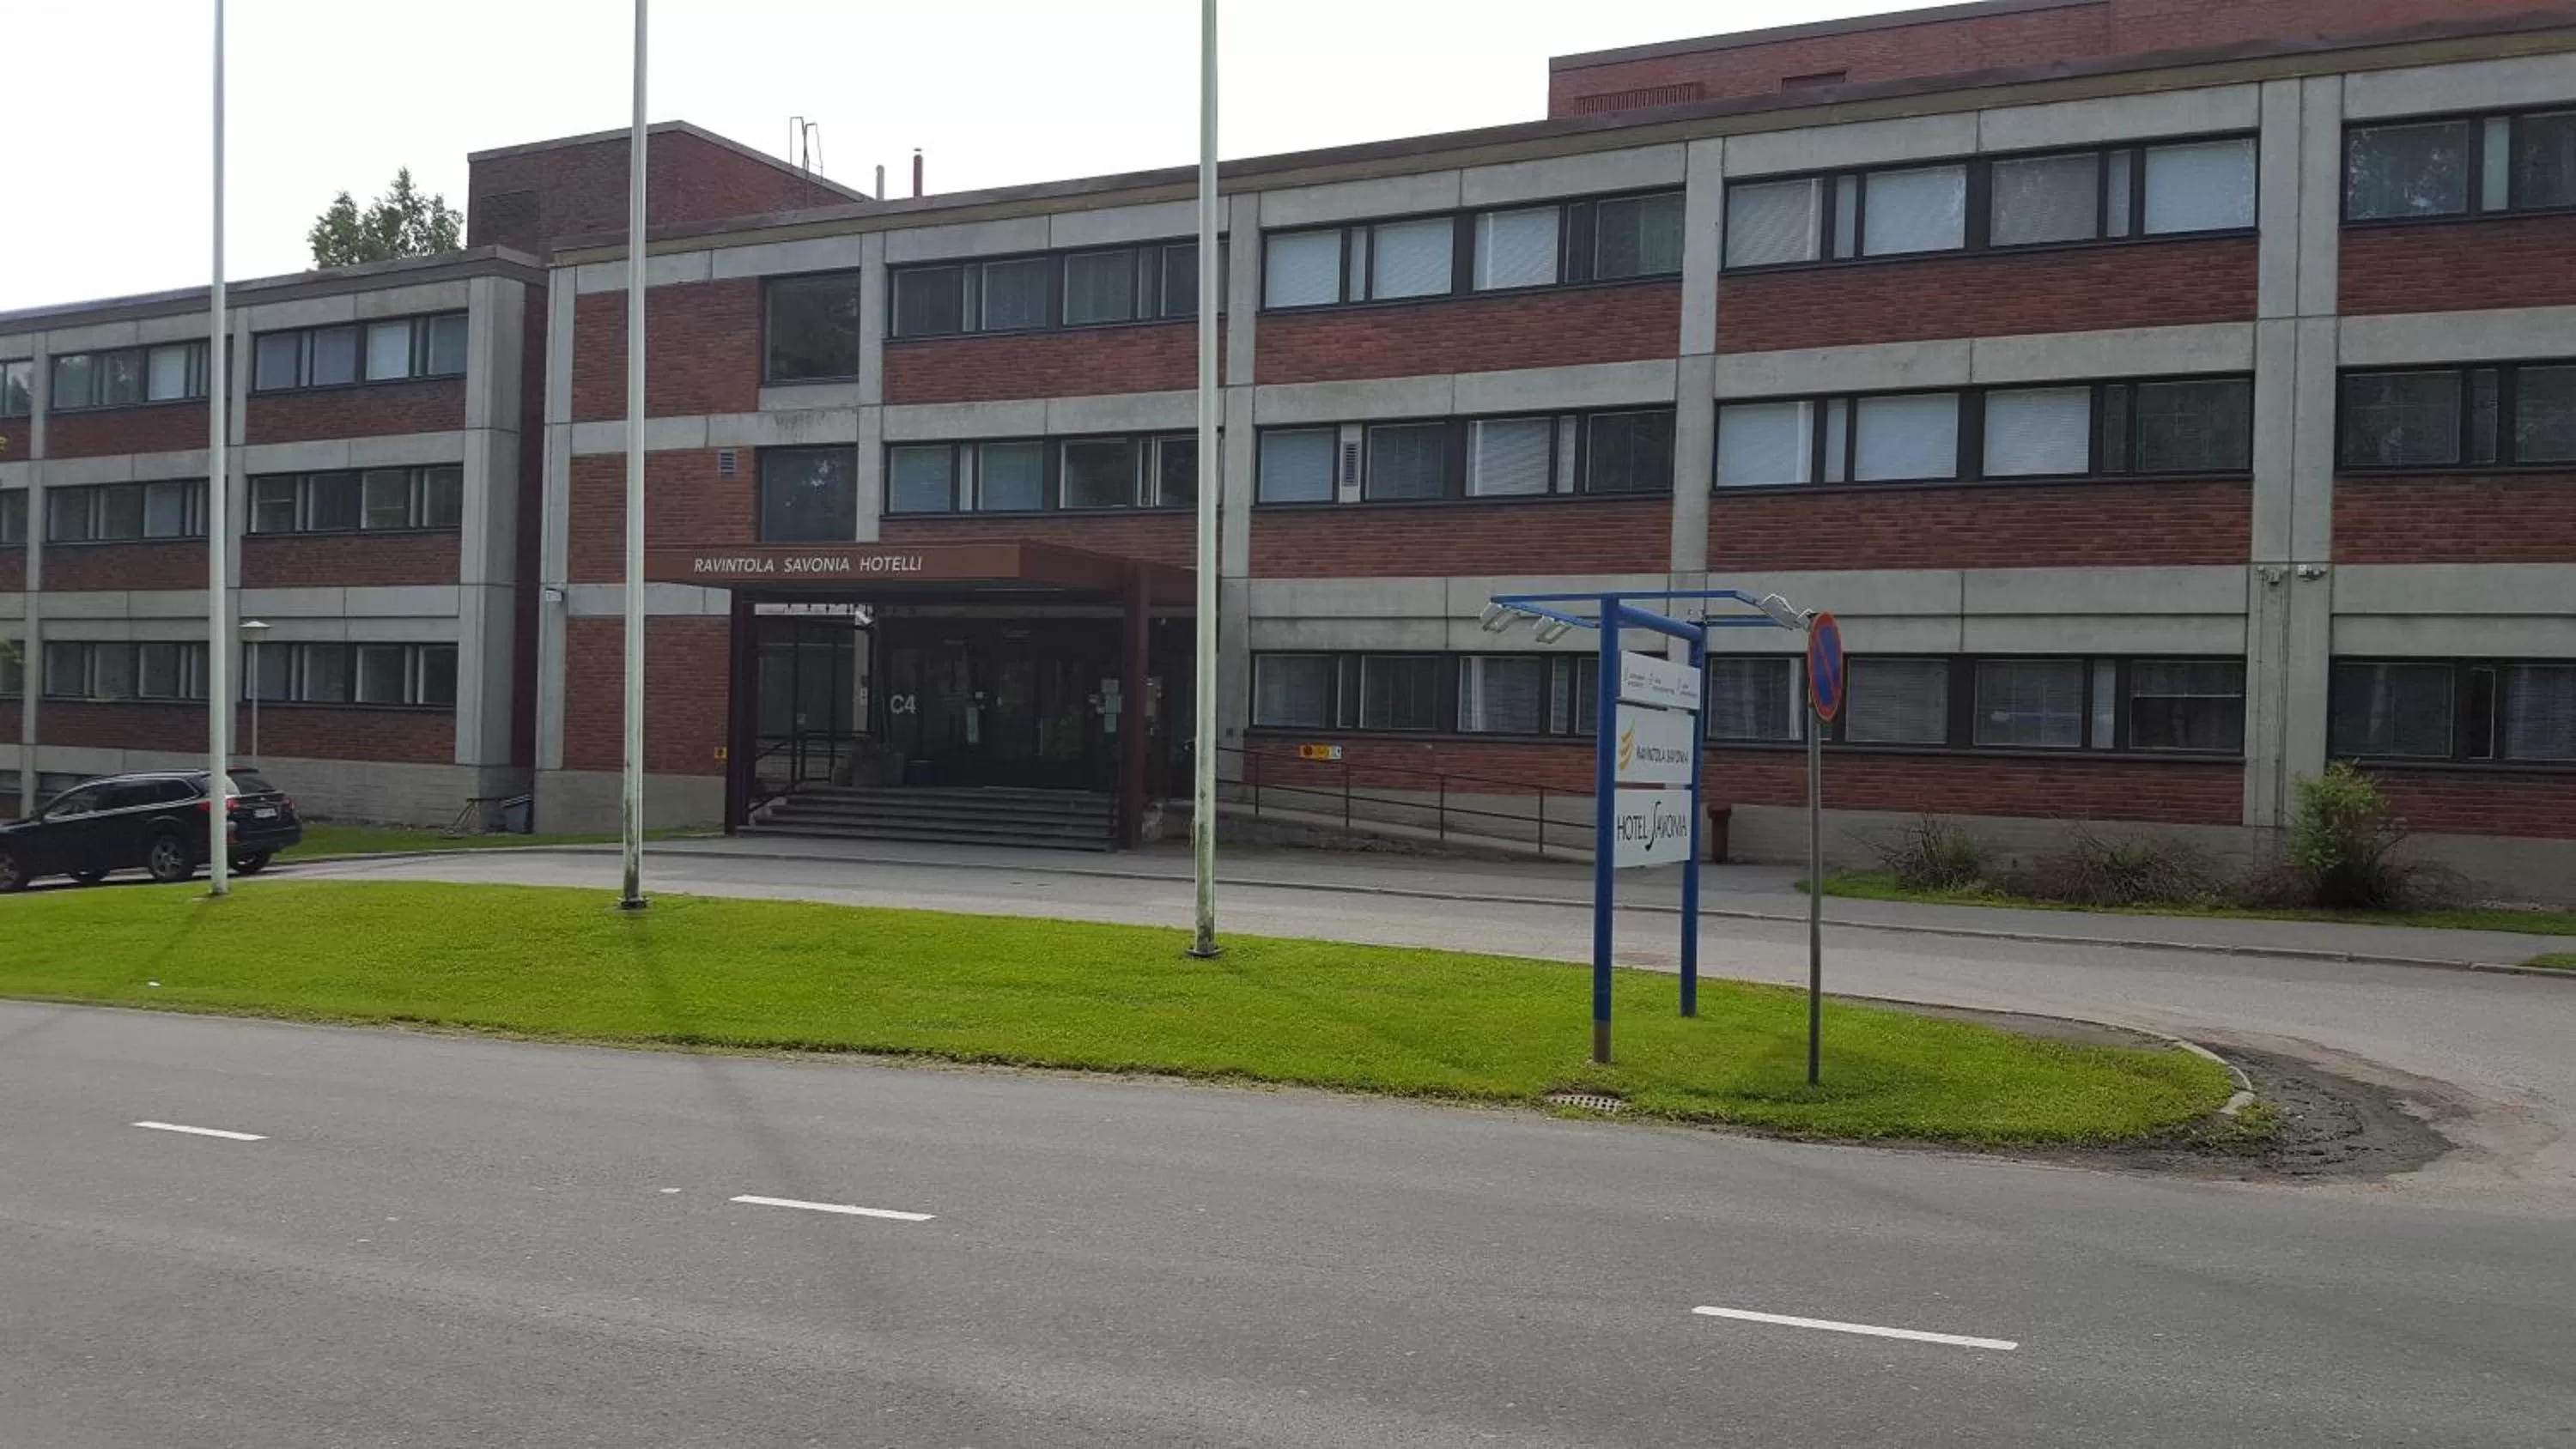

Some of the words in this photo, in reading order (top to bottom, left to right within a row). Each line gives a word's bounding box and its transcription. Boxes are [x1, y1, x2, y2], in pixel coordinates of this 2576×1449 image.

[693, 557, 774, 573] RAVINTOLA
[783, 556, 850, 573] SAVONIA
[859, 555, 923, 572] HOTELLI
[890, 694, 916, 714] C4
[1617, 815, 1648, 841] HOTEL
[1645, 800, 1687, 852] SAVONIA
